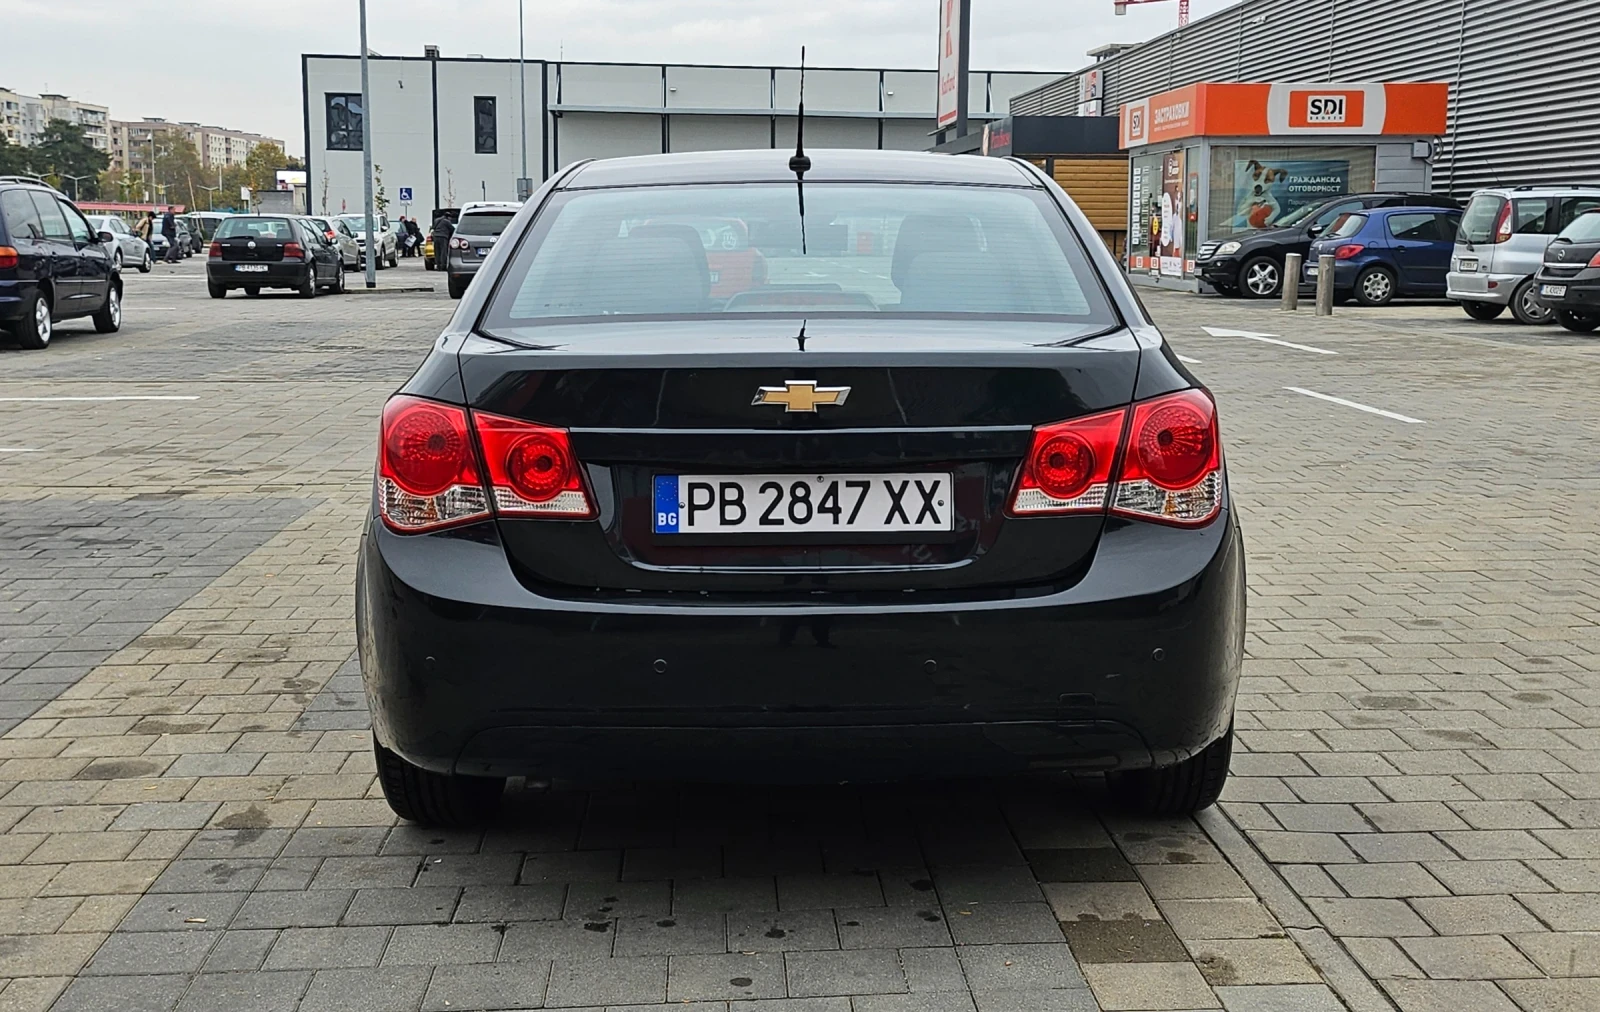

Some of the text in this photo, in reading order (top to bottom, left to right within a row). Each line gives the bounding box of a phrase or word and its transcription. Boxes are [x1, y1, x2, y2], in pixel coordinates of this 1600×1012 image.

[1310, 98, 1343, 115] SDI
[687, 480, 942, 526] PB 2847 XX
[657, 512, 677, 526] BG
